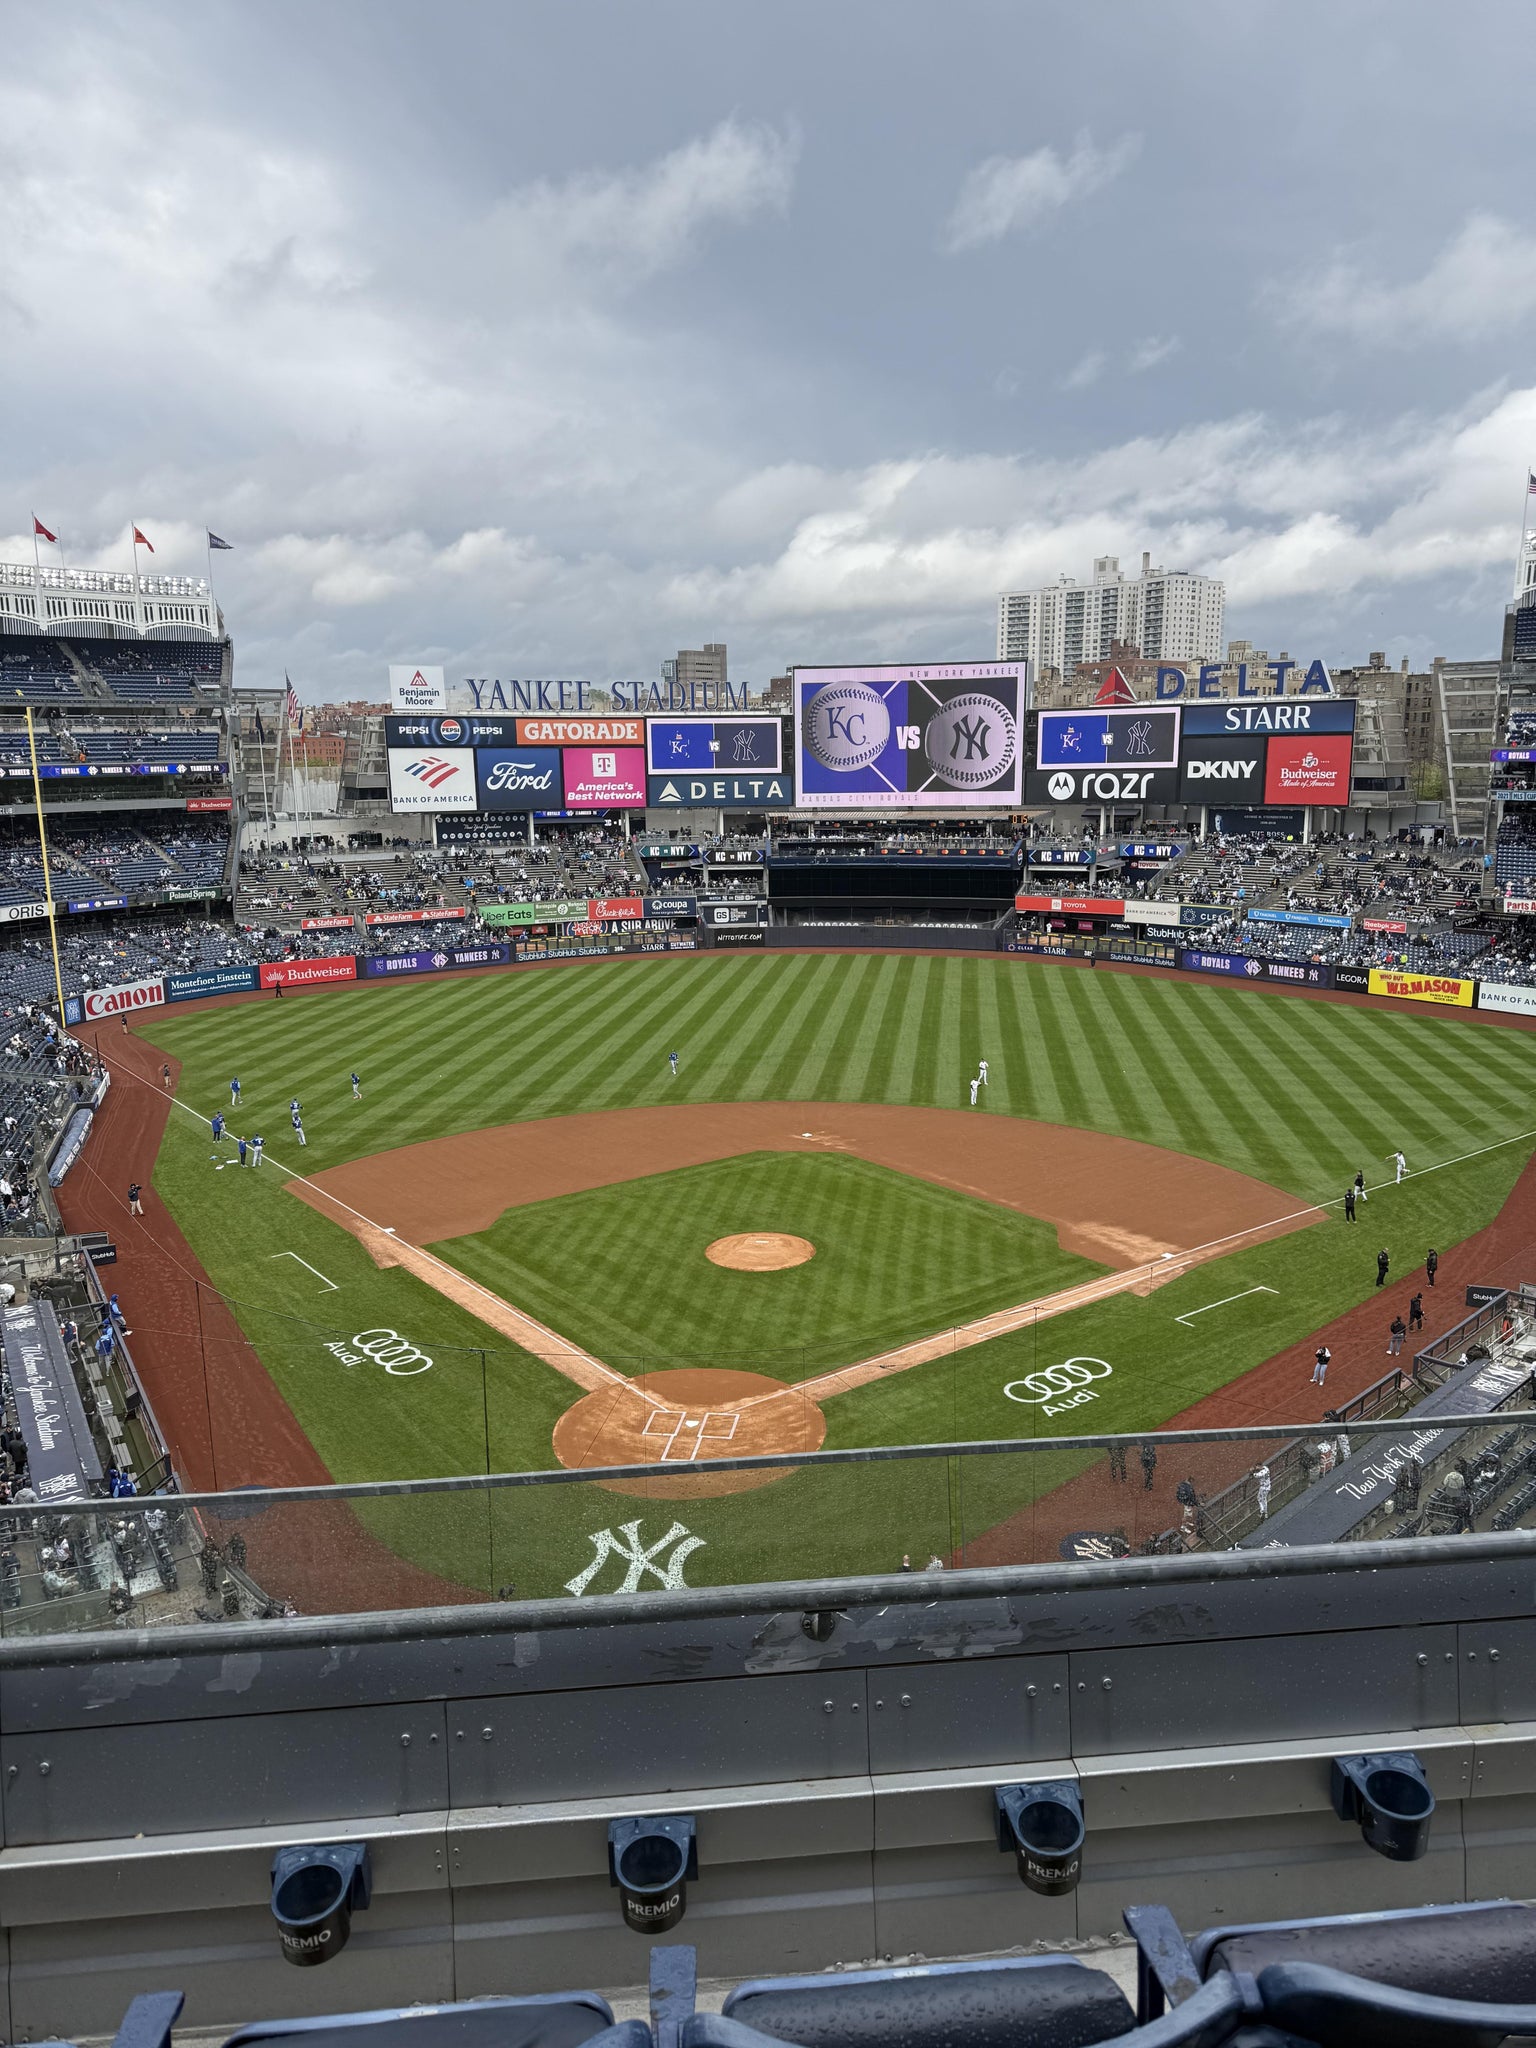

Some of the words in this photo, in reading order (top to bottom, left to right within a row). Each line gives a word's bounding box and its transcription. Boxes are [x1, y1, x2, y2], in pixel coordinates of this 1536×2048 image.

[938, 669, 964, 677] YORK
[972, 667, 1019, 676] YANKEES
[1156, 659, 1336, 700] DELTA
[399, 687, 440, 698] Benjamin
[463, 679, 594, 711] YANKEE
[611, 681, 750, 711] STADIUM
[405, 696, 434, 706] Moore
[1224, 705, 1311, 730] STARR
[398, 726, 429, 735] PEPSI
[472, 726, 503, 735] PEPSI
[524, 723, 639, 741] GATORADE
[896, 725, 920, 750] VS
[1102, 734, 1113, 744] VS
[709, 742, 720, 751] VS
[486, 761, 553, 790] Ford
[1187, 760, 1257, 779] DKNY
[1280, 767, 1338, 779] Budweiser
[576, 782, 634, 791] America's
[1082, 772, 1154, 800] razr
[1278, 779, 1300, 787] Made
[1300, 780, 1308, 788] of
[1307, 779, 1335, 787] America
[567, 791, 594, 801] Best
[594, 791, 643, 801] Network
[690, 781, 784, 799] DELTA
[393, 796, 418, 804] BANK
[433, 795, 474, 803] AMERICA
[649, 846, 660, 857] KC
[670, 845, 685, 856] NYY
[715, 851, 726, 862] KC
[737, 851, 753, 861] NYY
[1134, 845, 1145, 856] KC
[1156, 845, 1172, 856] NYY
[1041, 851, 1052, 862] KC
[1063, 851, 1080, 863] NYY
[169, 891, 194, 901] Poland
[194, 889, 216, 899] Spring
[662, 900, 688, 910] coupa
[1506, 901, 1530, 910] Parts
[9, 904, 45, 920] ORIS
[507, 910, 533, 920] Eats
[611, 922, 619, 933] A
[1365, 920, 1390, 930] Reebok
[1454, 916, 1478, 927] LEGORA
[1146, 927, 1185, 939] StubHub
[641, 943, 665, 951] STARR
[1043, 946, 1067, 956] STARR
[454, 951, 488, 963] YANKEES
[518, 952, 547, 961] StubHub
[547, 948, 577, 957] StubHub
[578, 946, 608, 956] StubHub
[386, 958, 417, 971] ROYALS
[1110, 953, 1132, 961] StubHub
[1132, 955, 1154, 964] StubHub
[1154, 958, 1176, 967] StubHub
[1201, 956, 1231, 970] ROYALS
[1268, 964, 1305, 979] YANKEES
[171, 977, 215, 990] Montefiore
[216, 971, 252, 983] Einstein
[1336, 973, 1368, 985] LEGORA
[85, 984, 163, 1016] Canon
[1481, 992, 1507, 1003] BANK
[1509, 996, 1522, 1004] OF
[91, 1251, 115, 1260] StubHub
[20, 1343, 45, 1377] Welcome
[322, 1341, 368, 1367] Audi
[16, 1380, 58, 1416] Yankee
[1041, 1388, 1101, 1417] Audi
[34, 1412, 63, 1451] Stadium
[1335, 1476, 1378, 1500] New
[1361, 1452, 1405, 1486] York
[1027, 1860, 1079, 1879] PREMIO
[627, 1893, 680, 1916] PREMIO
[278, 1928, 332, 1950] PREMIO
